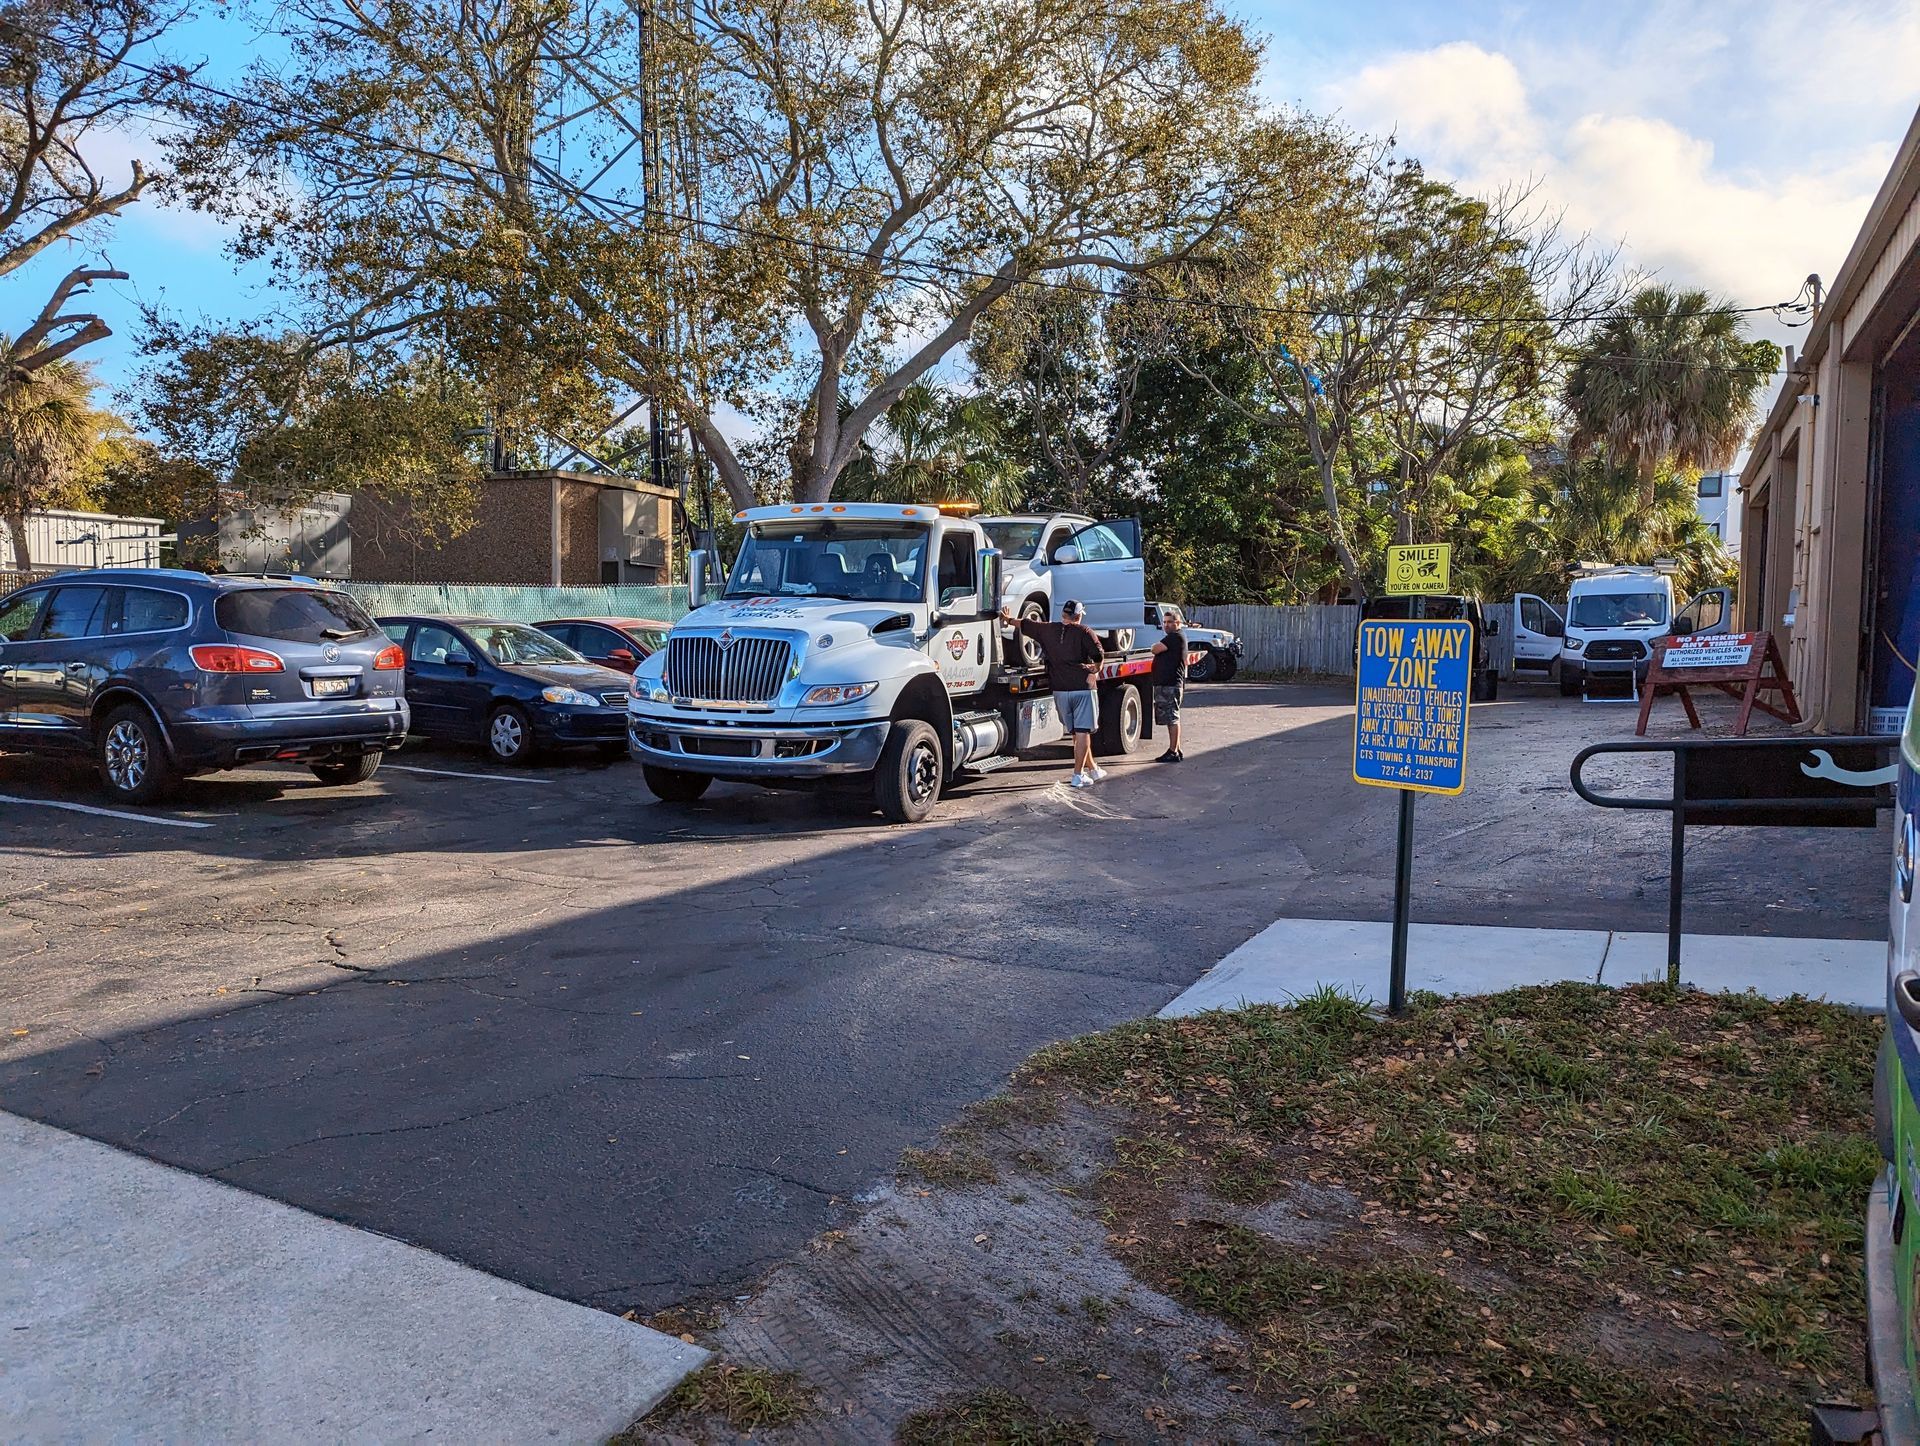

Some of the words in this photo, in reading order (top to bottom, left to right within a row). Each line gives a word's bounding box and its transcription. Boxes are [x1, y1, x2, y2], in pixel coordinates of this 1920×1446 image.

[1398, 548, 1440, 561] SMILE!
[1390, 583, 1410, 591] YOU'RE
[1412, 582, 1420, 590] ON
[1422, 582, 1445, 590] CAMERA
[1365, 626, 1404, 657] TOW
[1412, 628, 1466, 659] AWAY
[1696, 634, 1747, 642] PARKING
[1386, 657, 1439, 689] ZONE
[1362, 688, 1420, 705] UNAUTHORIZED
[1424, 691, 1463, 707] VEHICLES
[1361, 702, 1371, 717] OR
[1374, 703, 1403, 719] VESSELS
[1406, 705, 1422, 721] WILL
[1425, 706, 1435, 722] BE
[1438, 707, 1462, 724] TOWED
[1360, 718, 1379, 733] AWAY
[1382, 719, 1390, 734] AT
[1393, 720, 1424, 737] OWNERS
[1427, 723, 1460, 740] EXPENSE
[1360, 733, 1369, 746] 24
[1372, 734, 1386, 747] HRS.
[1388, 735, 1394, 748] A
[1396, 736, 1409, 749] DAY
[1412, 737, 1416, 750] 7
[1418, 738, 1436, 752] DAYS
[1438, 740, 1444, 753] A
[1447, 740, 1459, 754] WK.
[1360, 749, 1373, 760] CTS
[1376, 750, 1403, 763] TOWING
[1405, 754, 1412, 764] &
[1414, 754, 1458, 768] TRANSPORT
[1381, 765, 1433, 780] 727-441-2137
